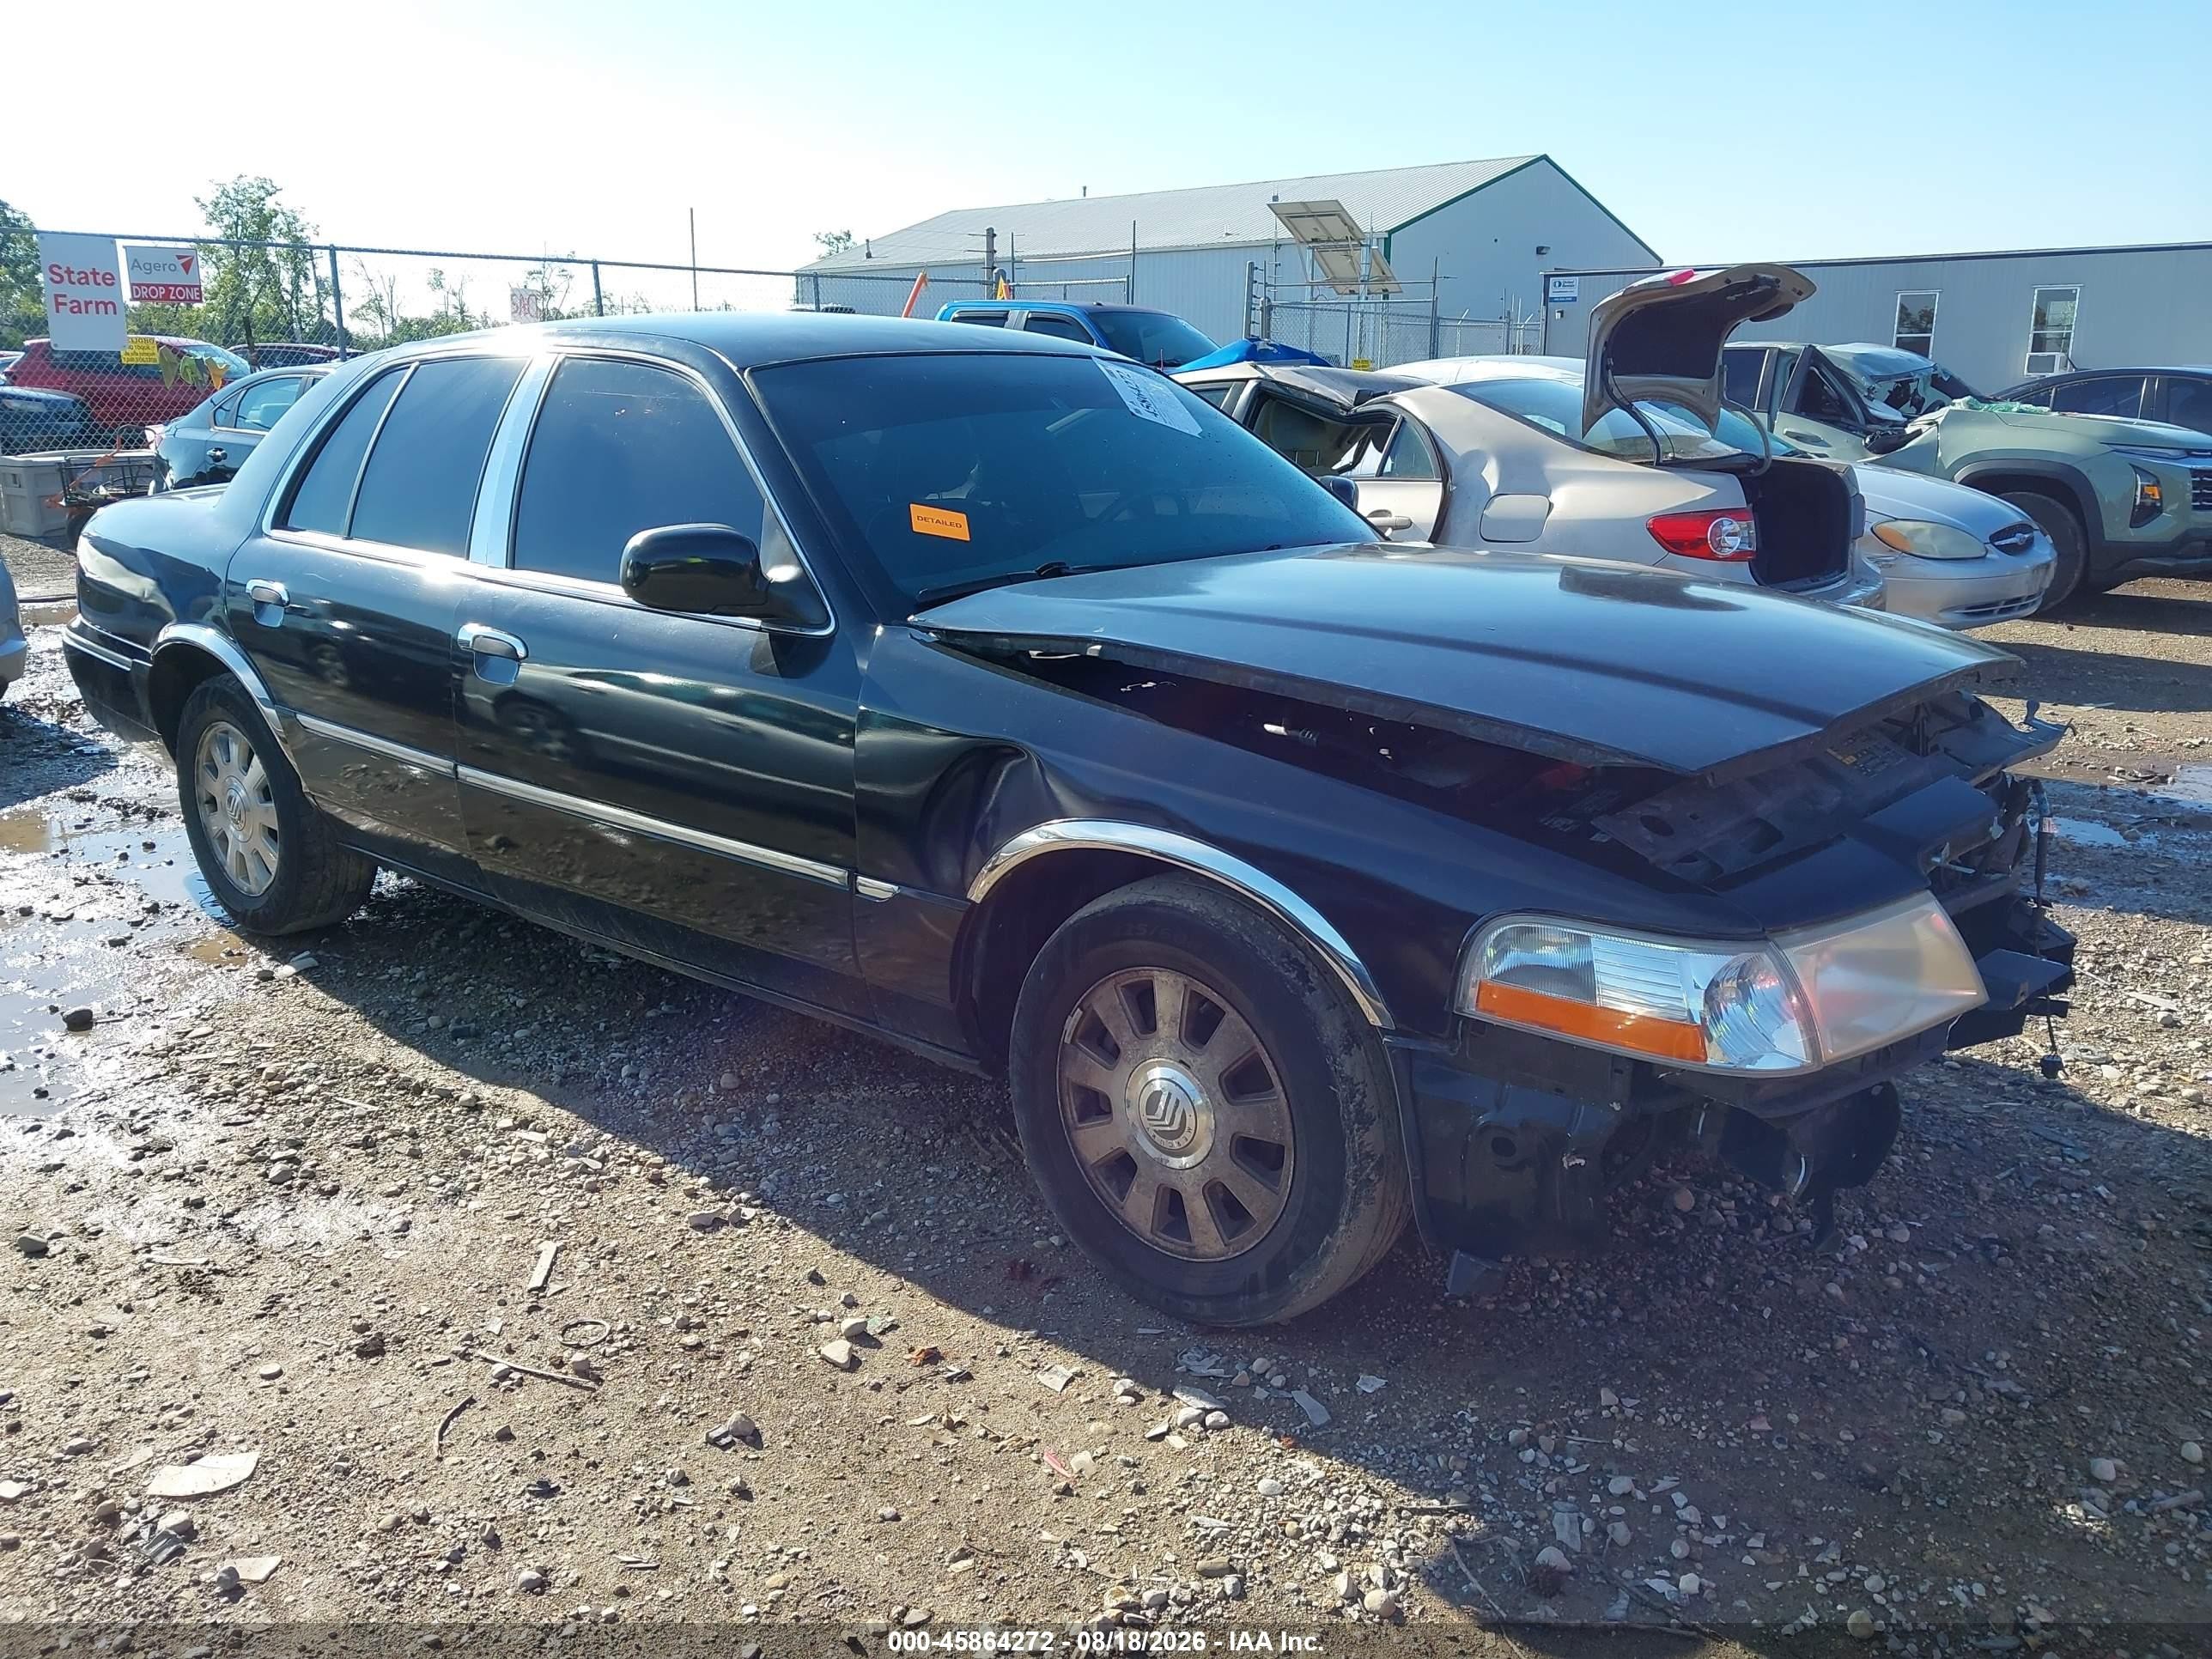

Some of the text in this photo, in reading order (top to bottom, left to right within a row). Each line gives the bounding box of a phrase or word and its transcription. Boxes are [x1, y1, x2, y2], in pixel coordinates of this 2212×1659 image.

[48, 263, 116, 287] State
[131, 258, 178, 275] Agero
[132, 285, 201, 301] DROP ZONE
[53, 293, 118, 315] Farm
[916, 515, 963, 529] DETAILED
